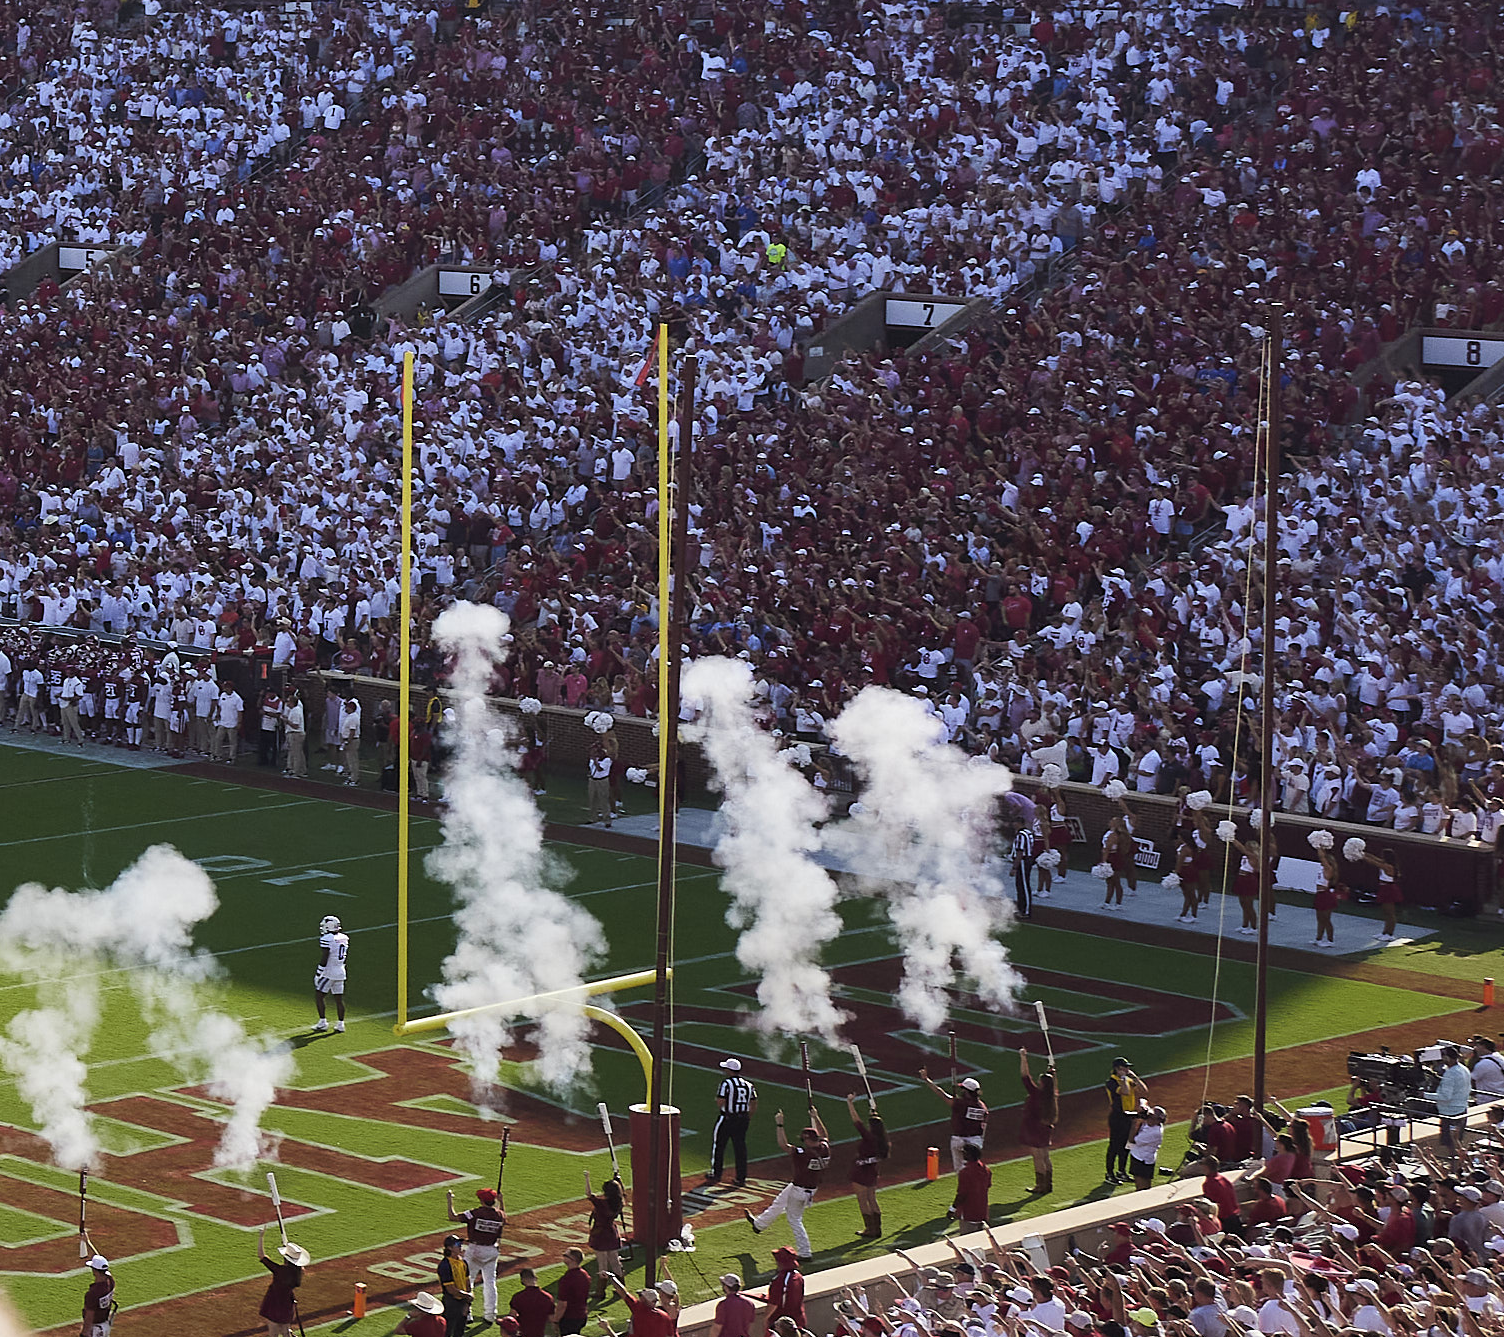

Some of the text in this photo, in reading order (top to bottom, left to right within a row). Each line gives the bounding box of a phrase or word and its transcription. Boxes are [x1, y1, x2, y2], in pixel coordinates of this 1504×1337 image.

[469, 274, 480, 294] 6
[922, 305, 934, 324] 7
[1466, 341, 1480, 364] 8
[736, 1087, 747, 1103] R
